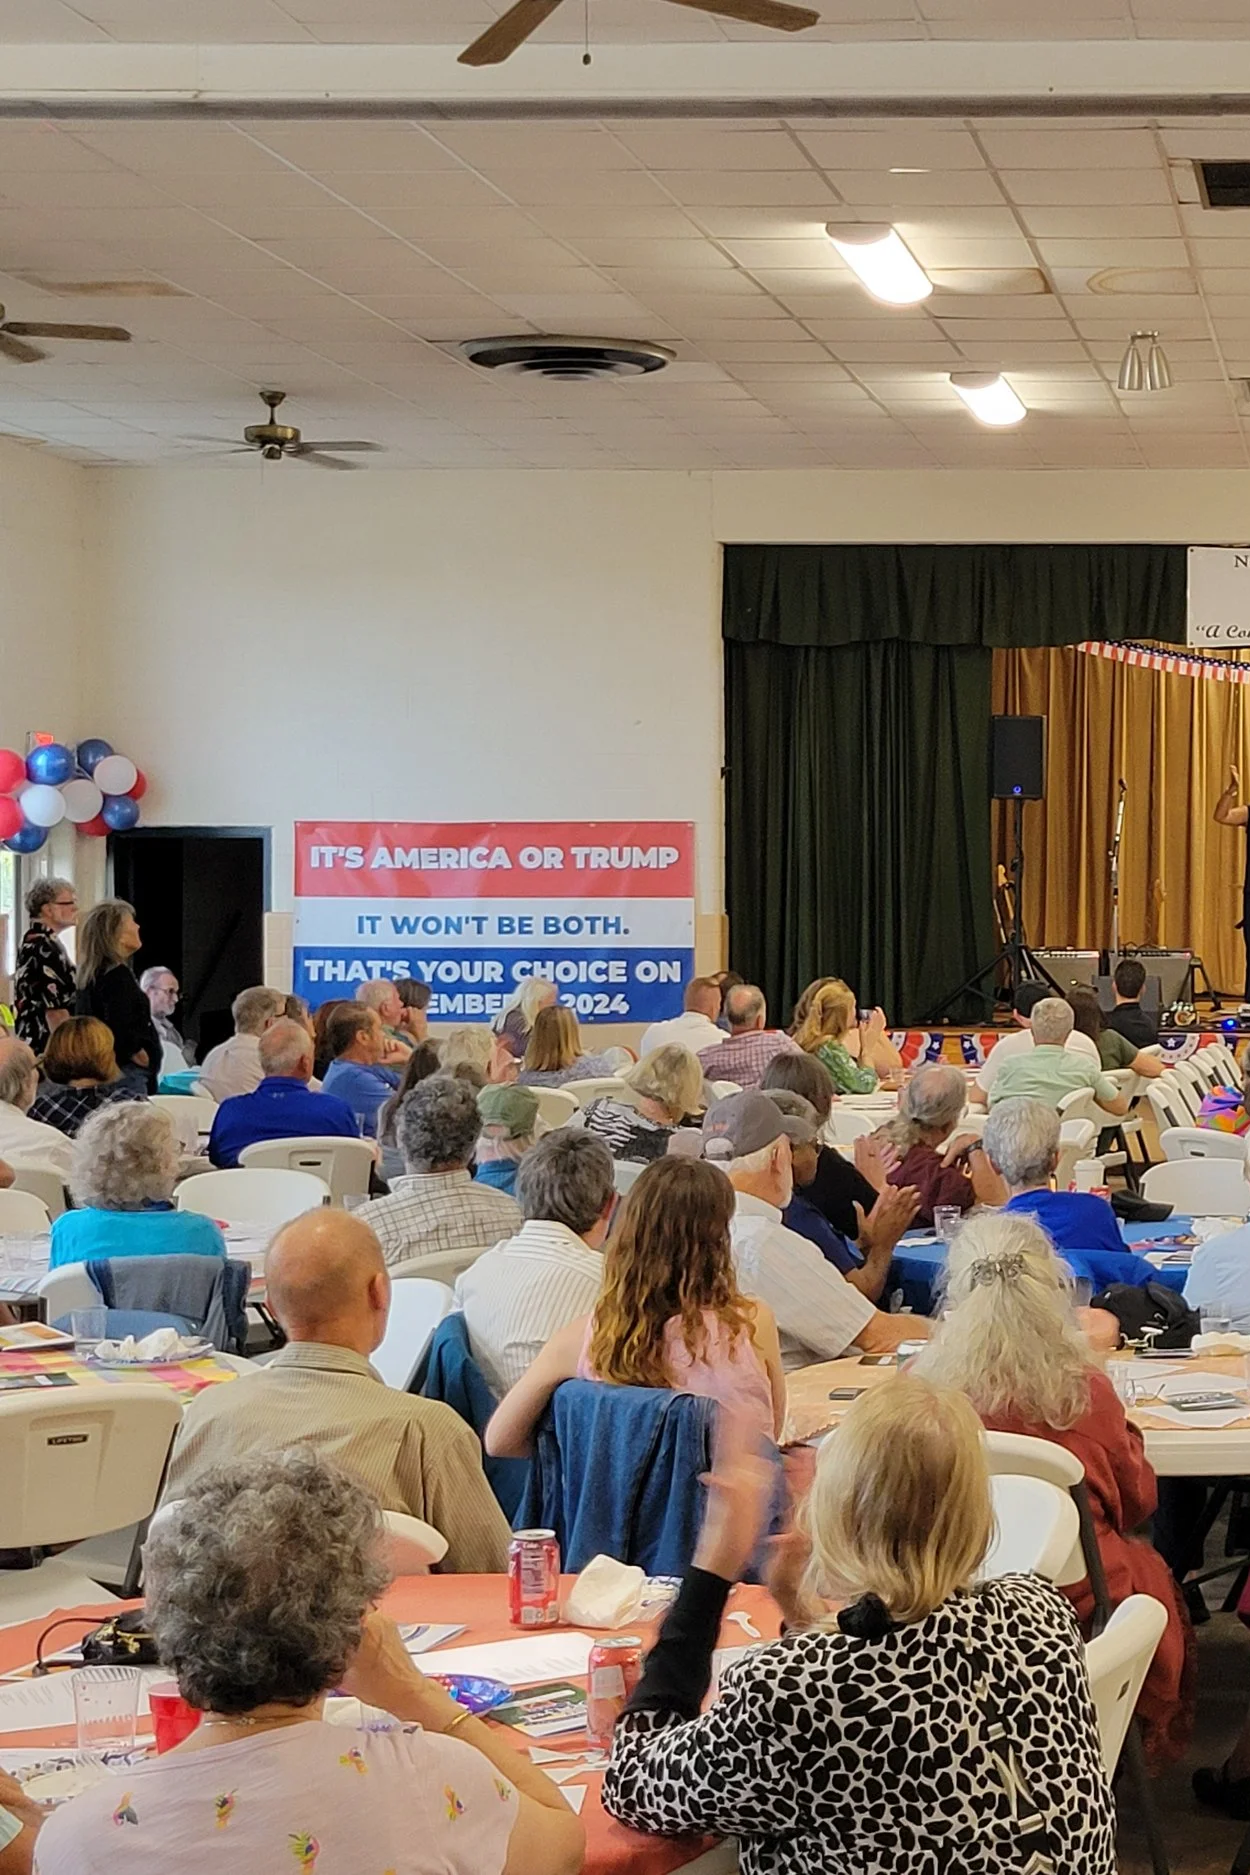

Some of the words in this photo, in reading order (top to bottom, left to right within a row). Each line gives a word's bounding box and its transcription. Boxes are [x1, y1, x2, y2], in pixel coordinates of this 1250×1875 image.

[310, 846, 364, 869] IT'S
[370, 847, 513, 870] AMERICA
[519, 846, 564, 869] OR
[570, 846, 679, 869] TRUMP
[357, 915, 382, 935] IT
[390, 915, 489, 935] WON'T
[497, 916, 534, 935] BE
[543, 916, 630, 935] BOTH.
[304, 960, 411, 981] THAT'S
[417, 960, 504, 982] YOUR
[511, 961, 628, 983] CHOICE
[635, 961, 681, 983] ON
[560, 994, 630, 1014] 2024
